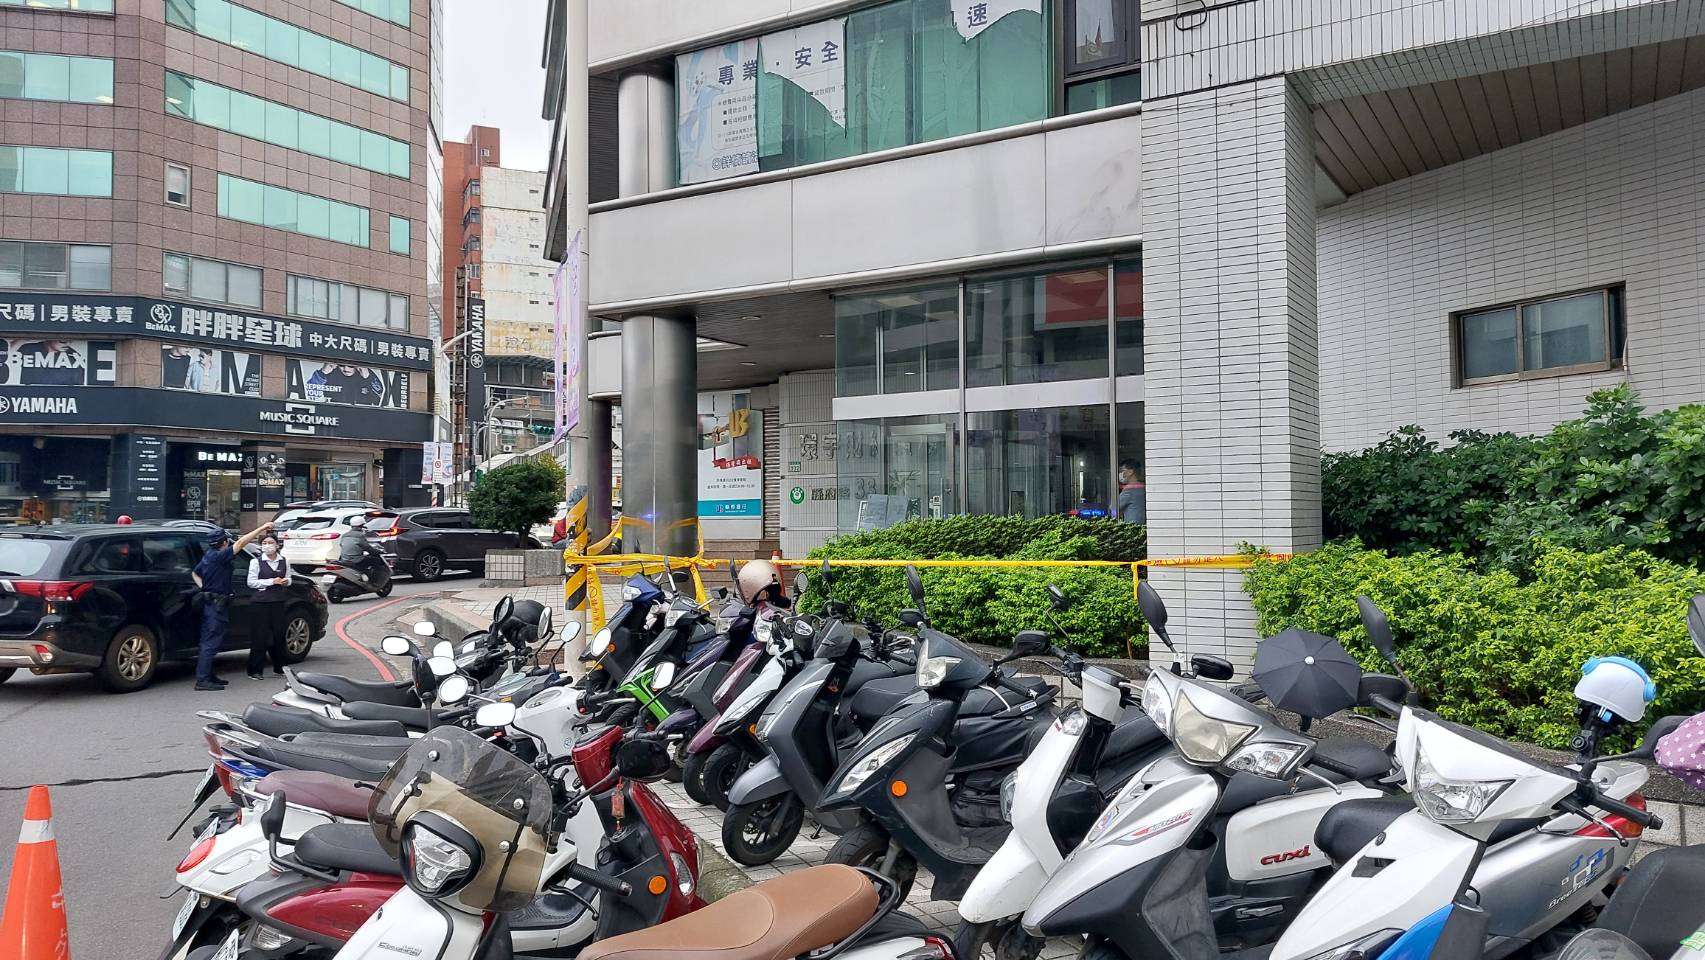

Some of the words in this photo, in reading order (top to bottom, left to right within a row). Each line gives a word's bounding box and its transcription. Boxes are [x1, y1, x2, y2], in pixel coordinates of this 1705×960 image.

[967, 2, 987, 28] 速
[718, 59, 757, 86] 專業
[181, 306, 303, 348] 胖胖星球
[472, 304, 483, 353] YAMAHA
[11, 397, 78, 414] YAMAHA
[259, 411, 298, 424] MUSIC
[297, 414, 340, 426] SQUARE
[1260, 845, 1312, 866] cuxi
